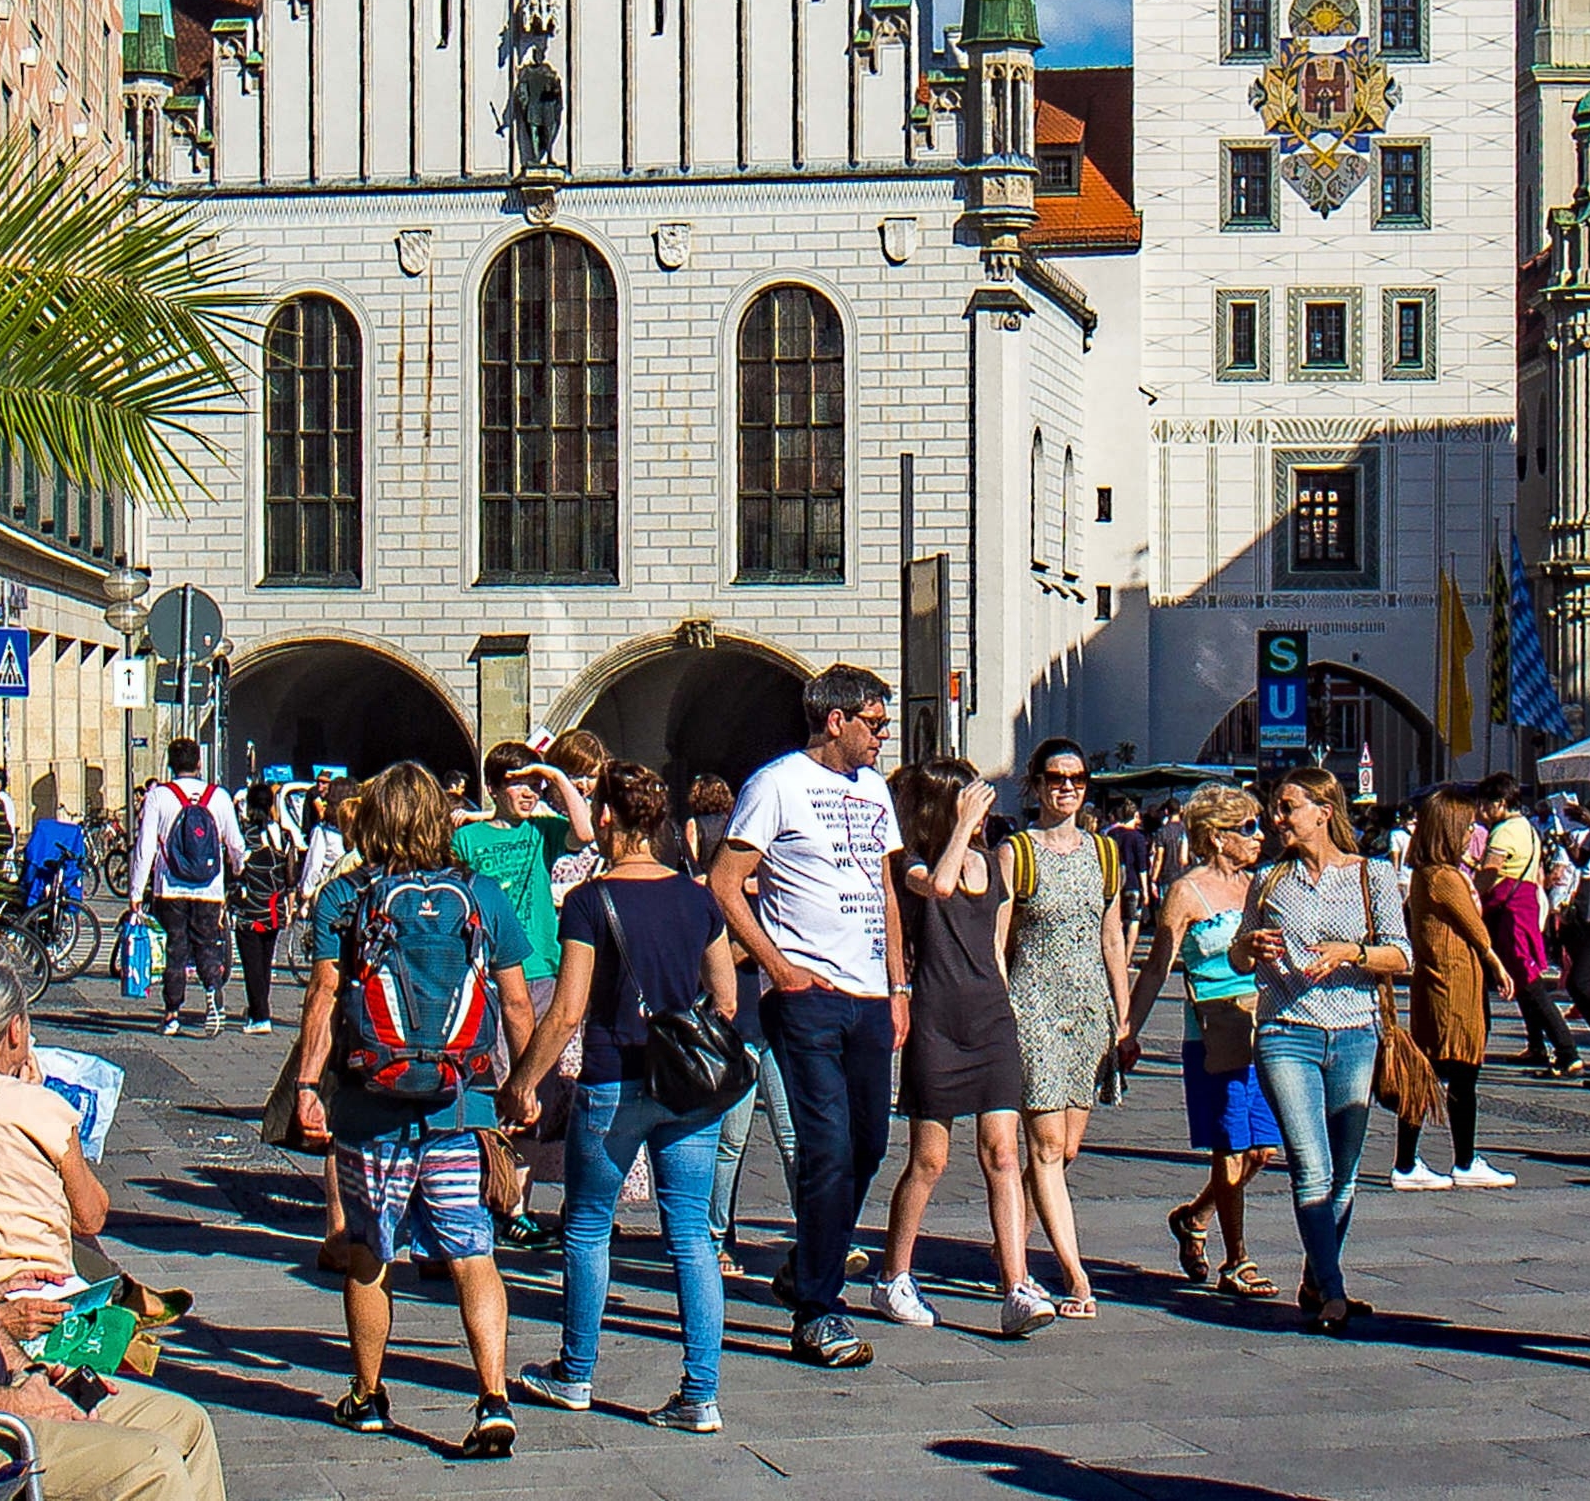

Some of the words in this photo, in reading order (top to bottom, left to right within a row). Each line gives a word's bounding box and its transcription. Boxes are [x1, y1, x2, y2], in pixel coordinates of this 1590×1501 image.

[1269, 637, 1298, 672] S
[1269, 684, 1296, 719] U
[840, 906, 857, 914] ON
